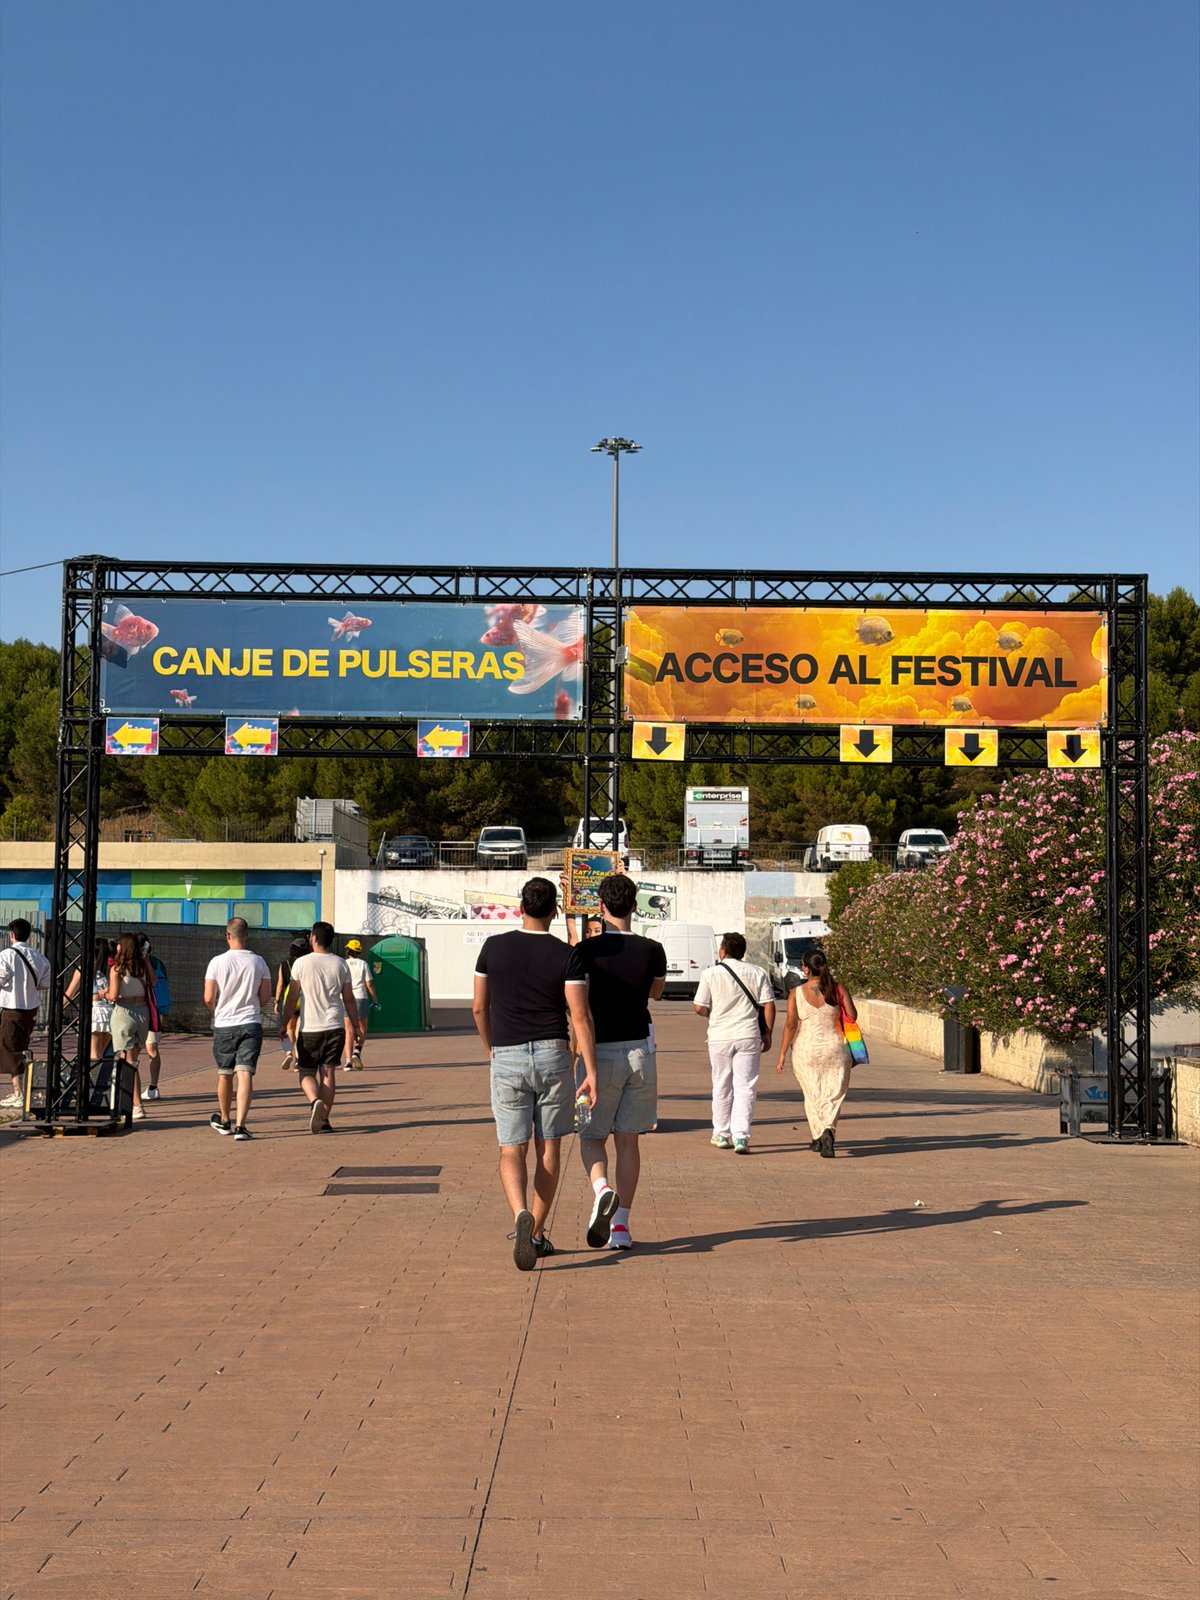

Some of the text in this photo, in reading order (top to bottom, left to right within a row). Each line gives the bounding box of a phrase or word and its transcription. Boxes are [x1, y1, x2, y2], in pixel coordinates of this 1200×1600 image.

[152, 646, 525, 680] CANJE DE PULSERAS
[655, 652, 1078, 688] ACCESO AL FESTIVAL
[695, 792, 742, 800] enterprise
